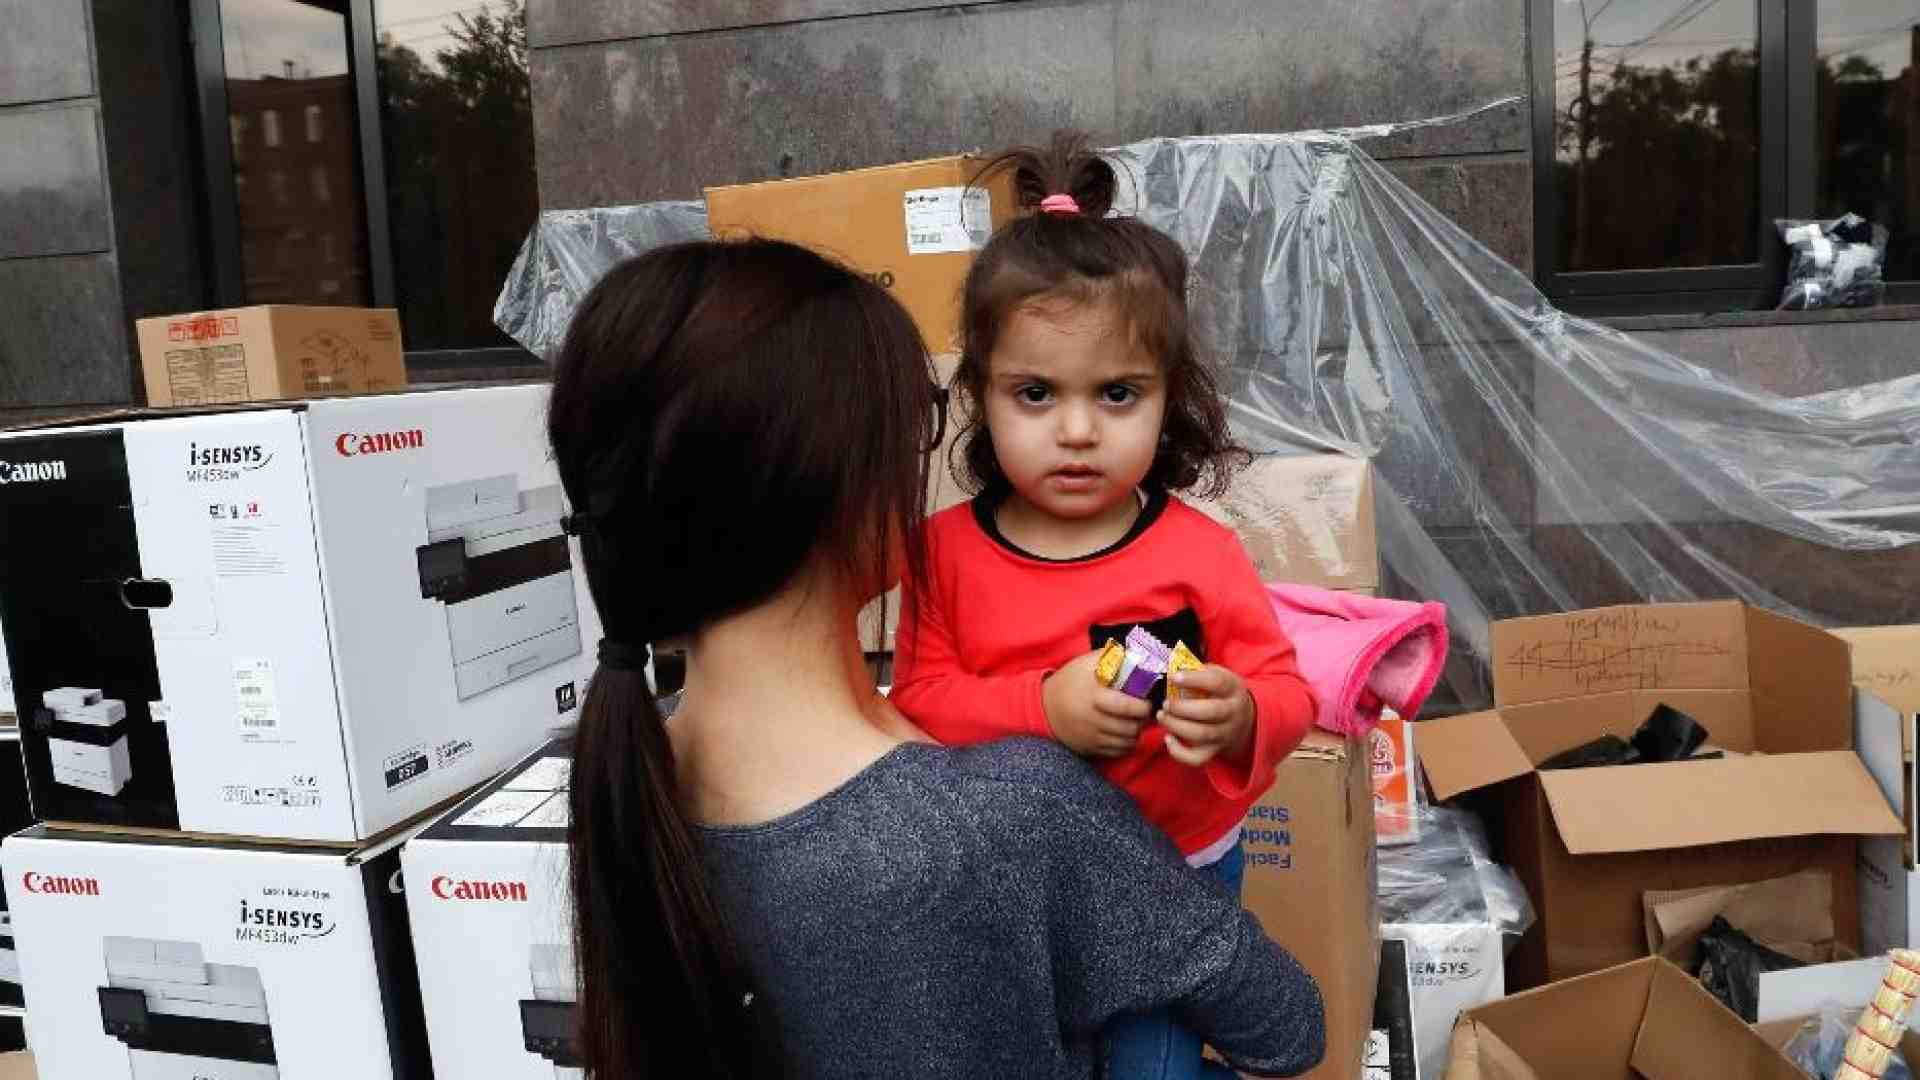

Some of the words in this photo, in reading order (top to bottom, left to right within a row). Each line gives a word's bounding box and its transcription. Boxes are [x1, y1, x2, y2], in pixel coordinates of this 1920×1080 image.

[191, 441, 262, 466] i-SENSYS
[336, 429, 424, 457] Canon
[0, 459, 66, 483] Canon
[23, 871, 100, 896] Canon
[431, 875, 528, 901] Canon
[240, 899, 323, 929] i-SENSYS
